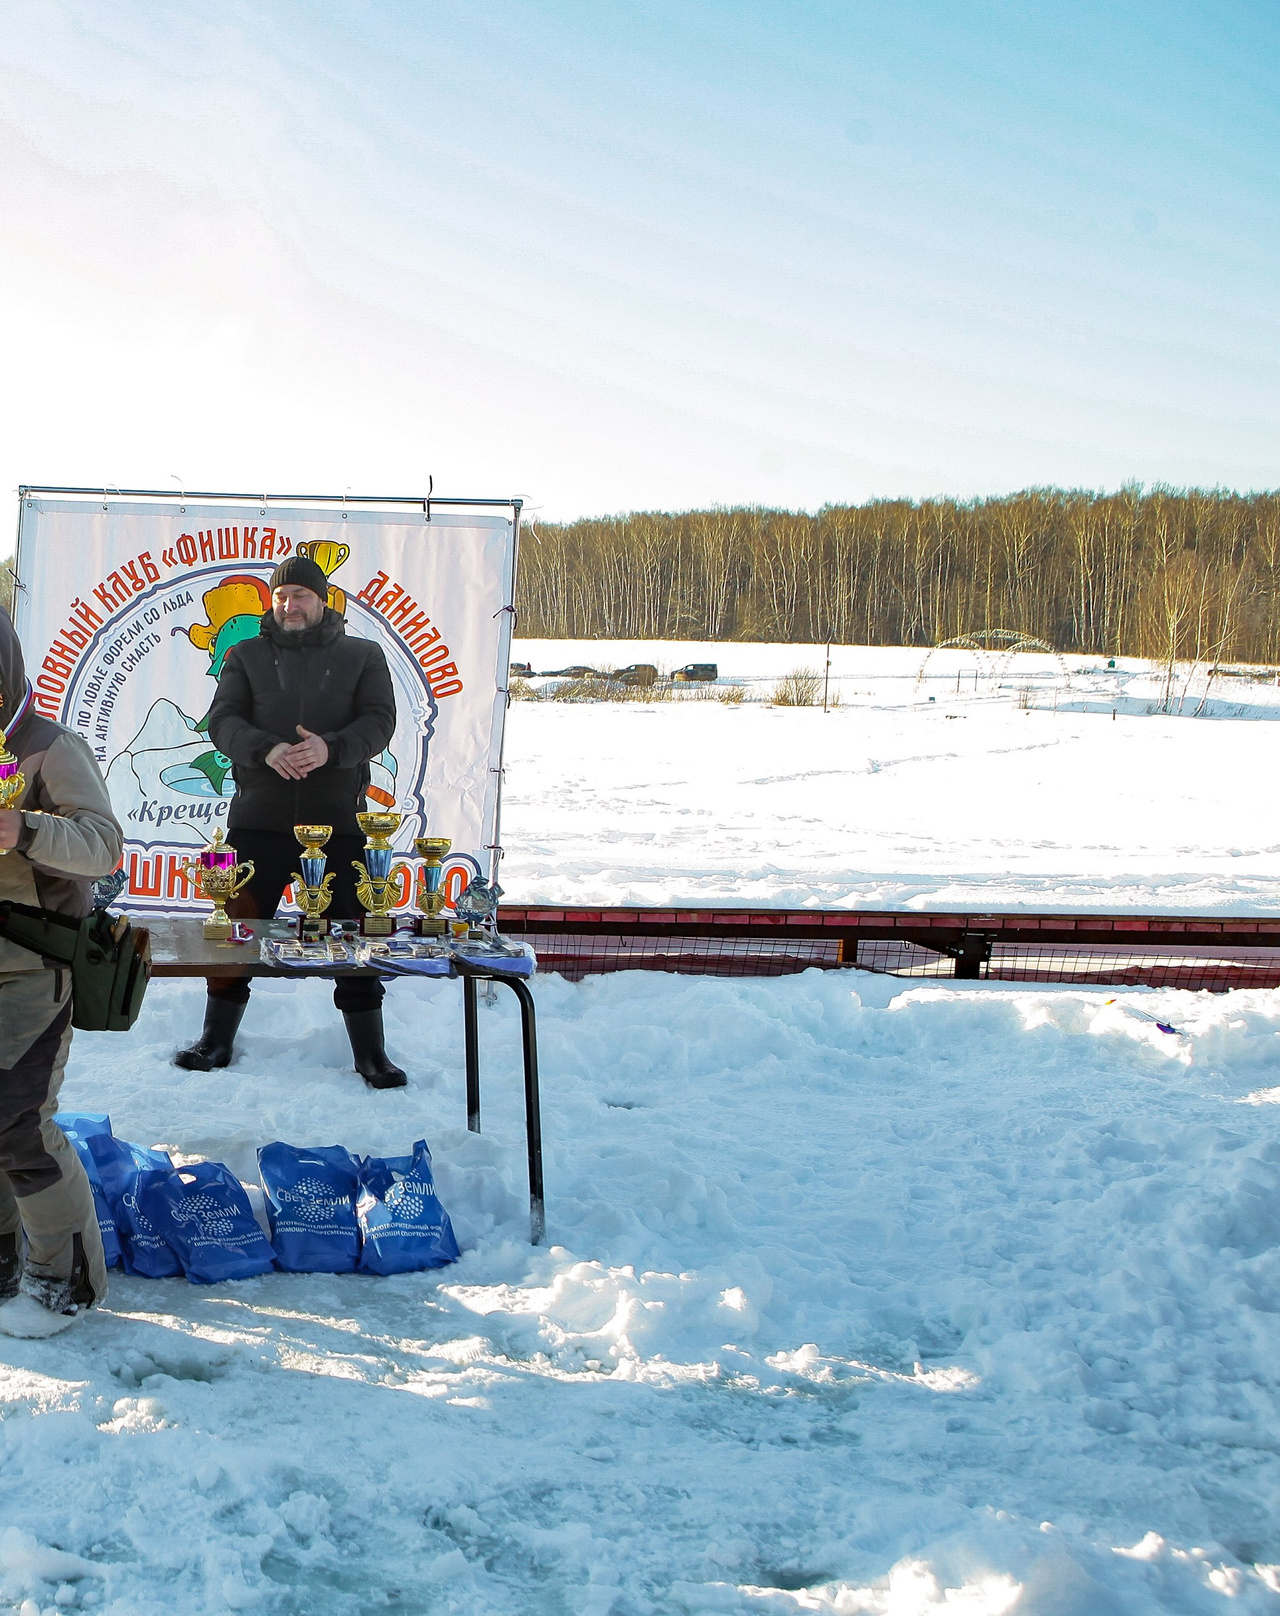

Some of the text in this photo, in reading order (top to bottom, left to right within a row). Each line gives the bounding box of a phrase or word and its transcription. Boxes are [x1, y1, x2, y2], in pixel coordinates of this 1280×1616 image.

[92, 550, 161, 614] КЛУБ
[161, 526, 293, 568] «ФИШКА»
[356, 570, 464, 699] ДАНИЛОВО
[162, 590, 194, 615] ЛЬДА
[144, 607, 160, 626] СО
[102, 619, 145, 666] ФОРЕЛИ
[82, 666, 108, 710] ЛОВЛЕ
[95, 632, 162, 762] НА АКТИВНУЮ СНАСТЬ
[77, 711, 91, 727] ПО
[127, 800, 228, 828] «Креще
[276, 1188, 350, 1206] Свет Земли
[397, 1181, 437, 1197] Земли
[198, 1203, 241, 1221] Земли
[276, 1226, 307, 1234] ПОМОЩИ
